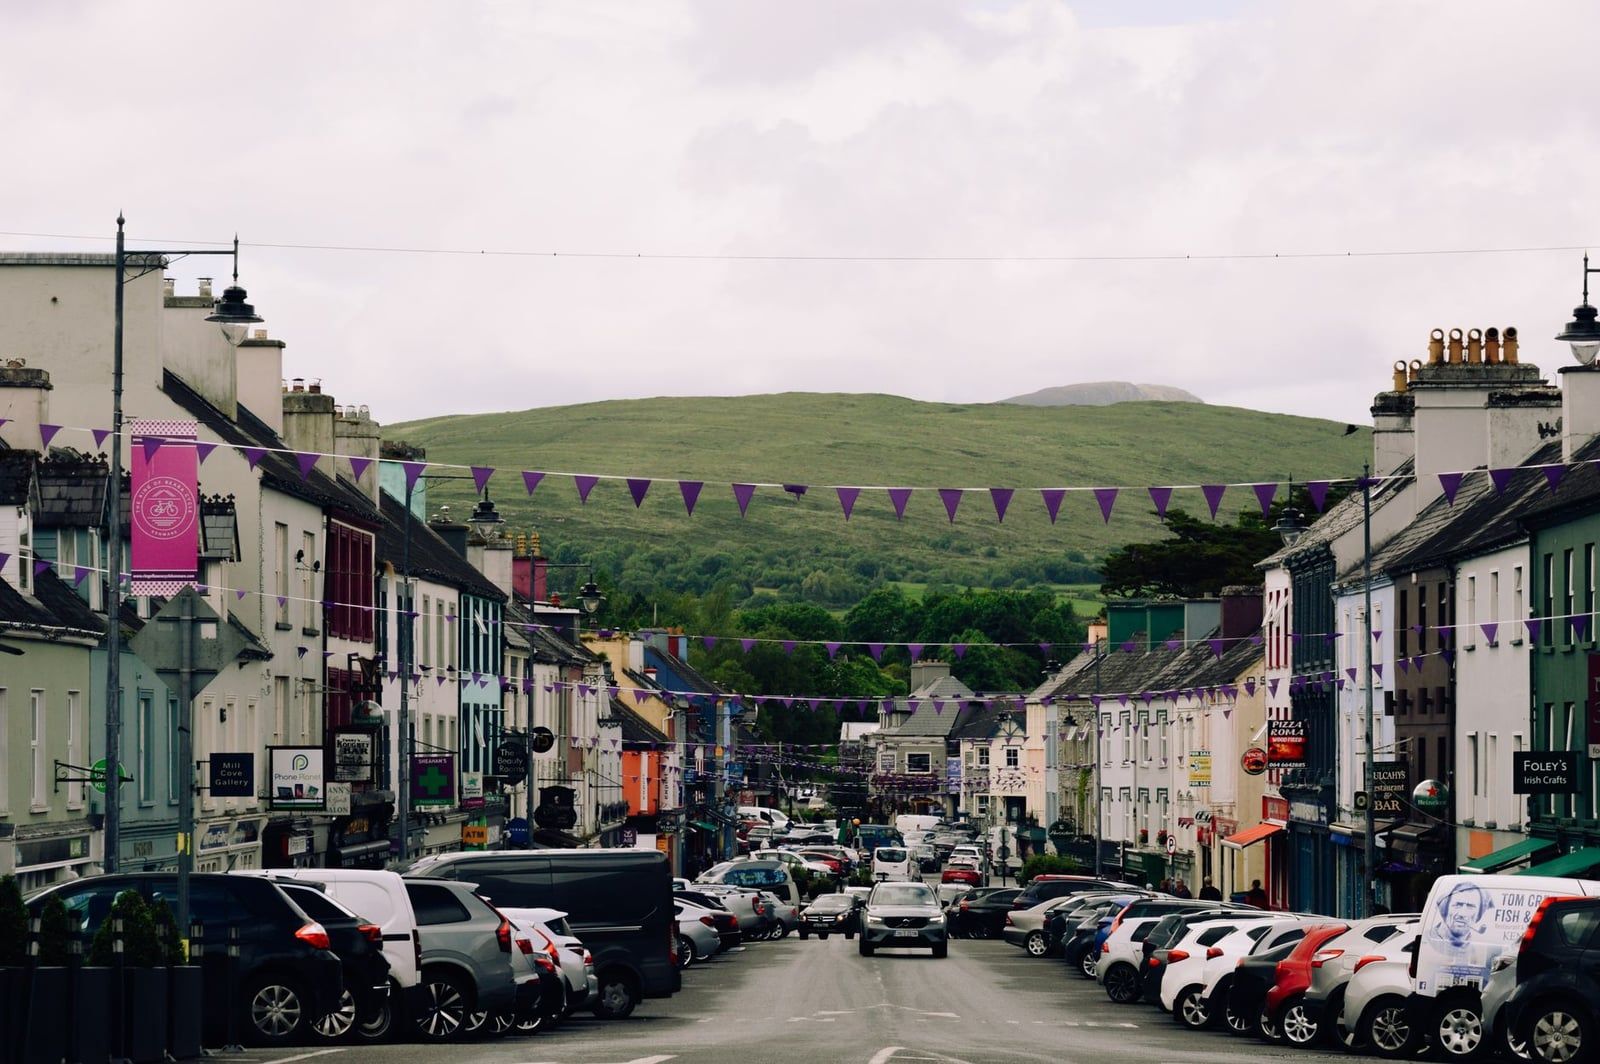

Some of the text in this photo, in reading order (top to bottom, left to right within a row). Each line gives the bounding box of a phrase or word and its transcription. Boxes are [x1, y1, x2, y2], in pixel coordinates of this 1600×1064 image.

[184, 492, 193, 513] CYCLE
[497, 756, 523, 765] Beauty
[1523, 760, 1567, 771] FOLEY'S
[499, 765, 525, 773] Rooms
[215, 779, 249, 787] Gallery
[1524, 776, 1567, 784] Irish Crafts
[1374, 784, 1404, 792] estaurant
[1374, 800, 1401, 811] BAR
[1502, 893, 1525, 907] TOM
[1494, 909, 1531, 923] FISH &
